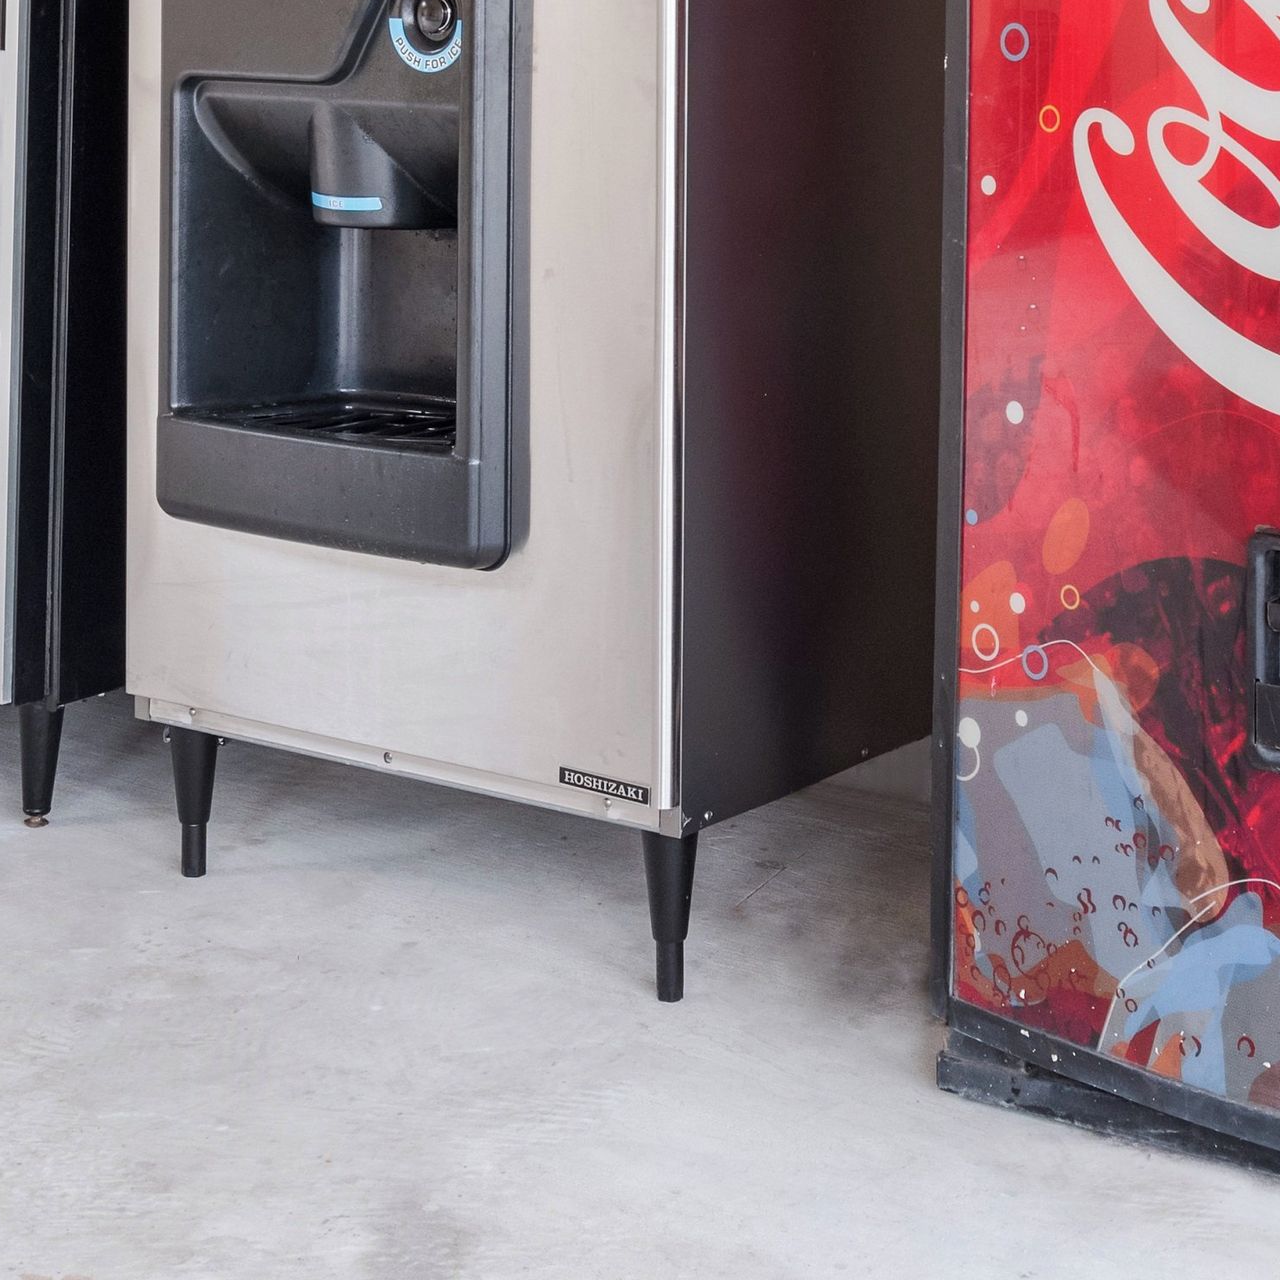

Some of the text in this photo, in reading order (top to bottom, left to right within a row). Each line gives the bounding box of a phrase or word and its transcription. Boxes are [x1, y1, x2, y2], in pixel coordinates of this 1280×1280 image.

[396, 36, 462, 70] PUSH FOR ICE
[328, 200, 343, 208] ICE
[564, 770, 644, 801] HOSHIZAKI
